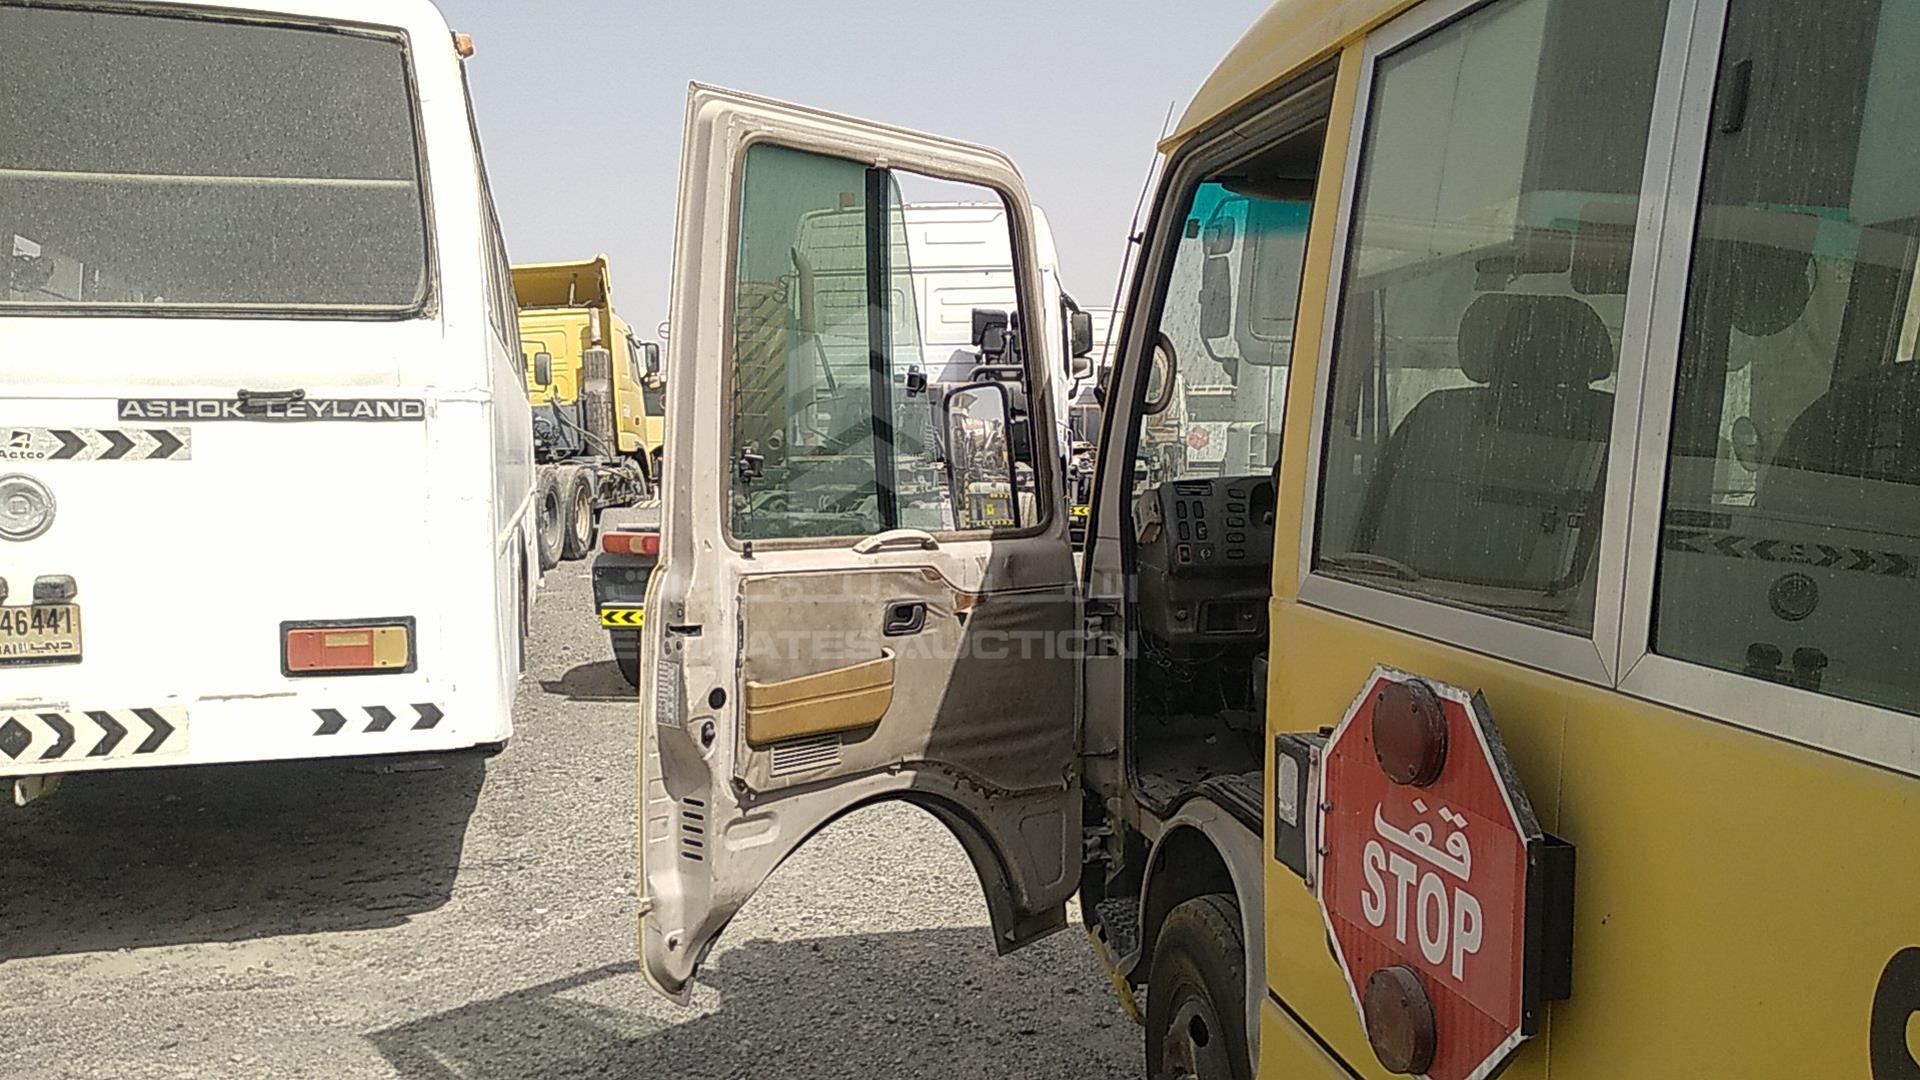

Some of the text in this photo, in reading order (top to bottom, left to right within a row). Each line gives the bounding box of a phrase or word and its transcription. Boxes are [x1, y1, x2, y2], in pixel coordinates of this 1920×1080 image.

[120, 400, 424, 418] ASHOK LEYLAND
[0, 644, 17, 655] AI
[30, 641, 73, 654] دبي
[1373, 798, 1472, 883] قف
[1361, 839, 1484, 983] STOP
